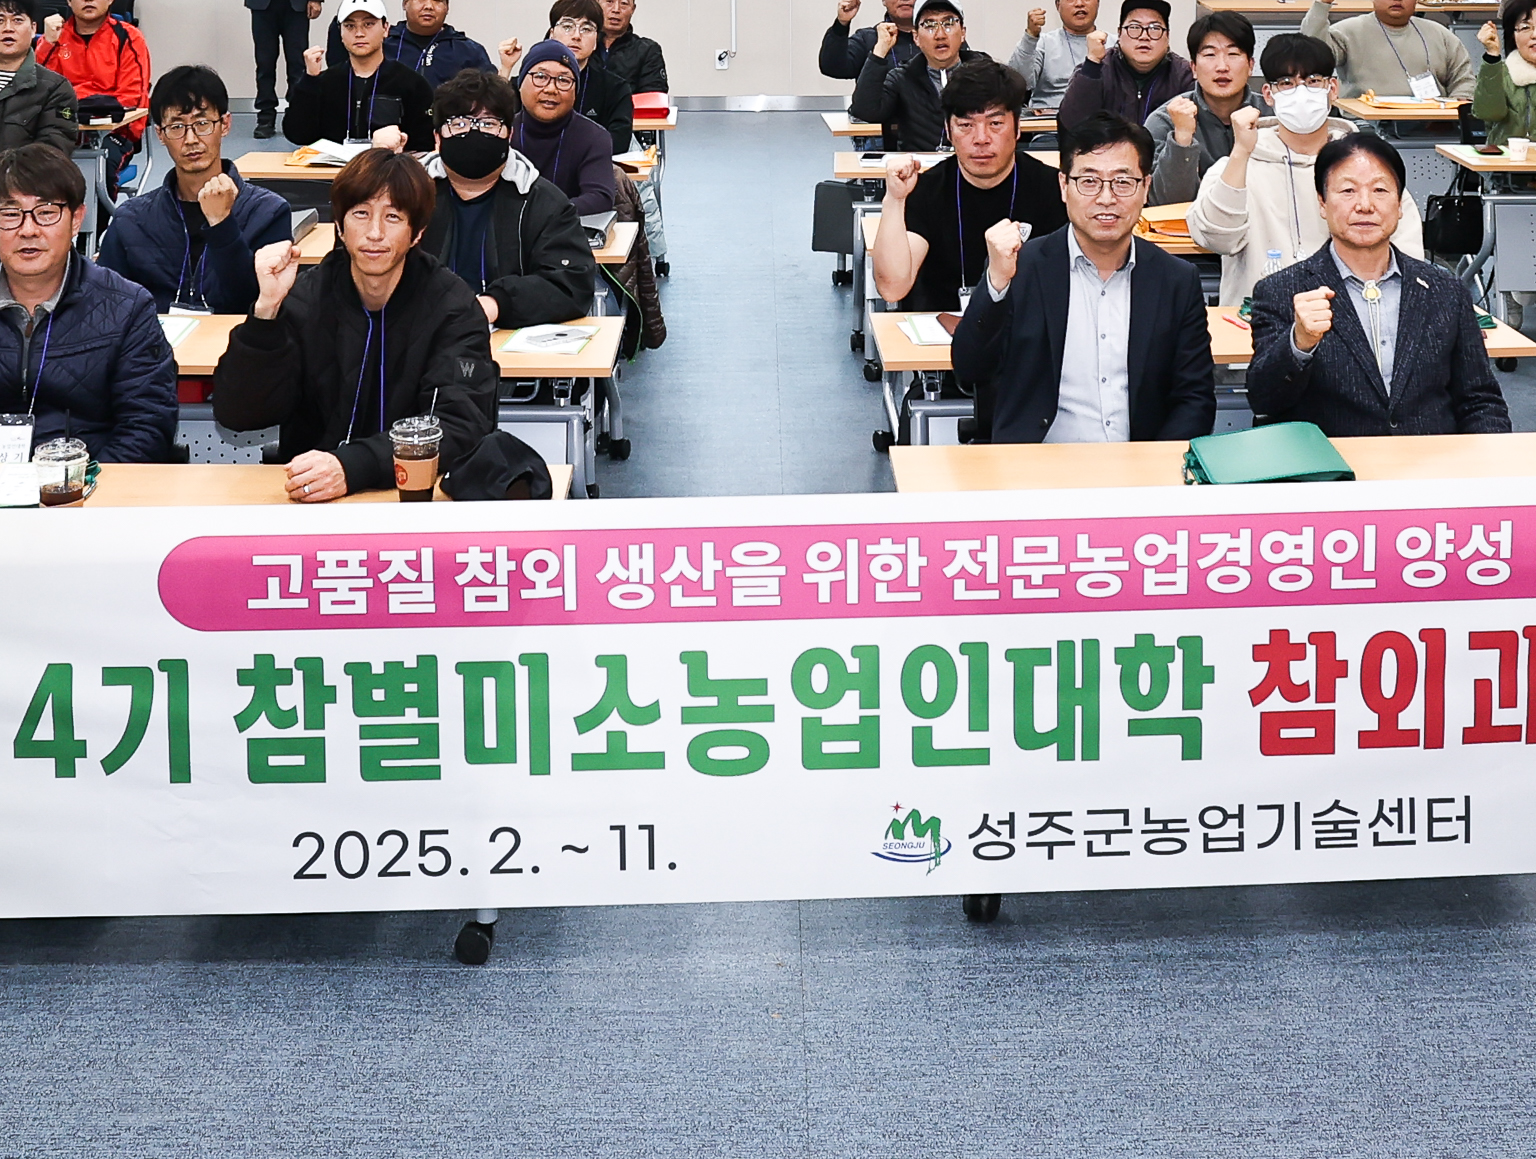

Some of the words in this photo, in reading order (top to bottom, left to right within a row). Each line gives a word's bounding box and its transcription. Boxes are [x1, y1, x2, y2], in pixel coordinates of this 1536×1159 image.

[247, 546, 437, 616] 고품질
[454, 543, 578, 613] 참외
[595, 540, 787, 610] 생산을
[802, 534, 928, 606] 위한
[942, 524, 1378, 602] 전문농업경영인
[1395, 519, 1513, 589] 양성
[232, 633, 1216, 785] 참별미소농업인대학
[292, 829, 469, 881] 2025.
[488, 826, 540, 876] 2.
[561, 844, 589, 854] ~
[609, 824, 678, 872] 11.
[882, 841, 926, 851] SEONGJU
[967, 794, 1476, 862] 성주군농업기술센터
